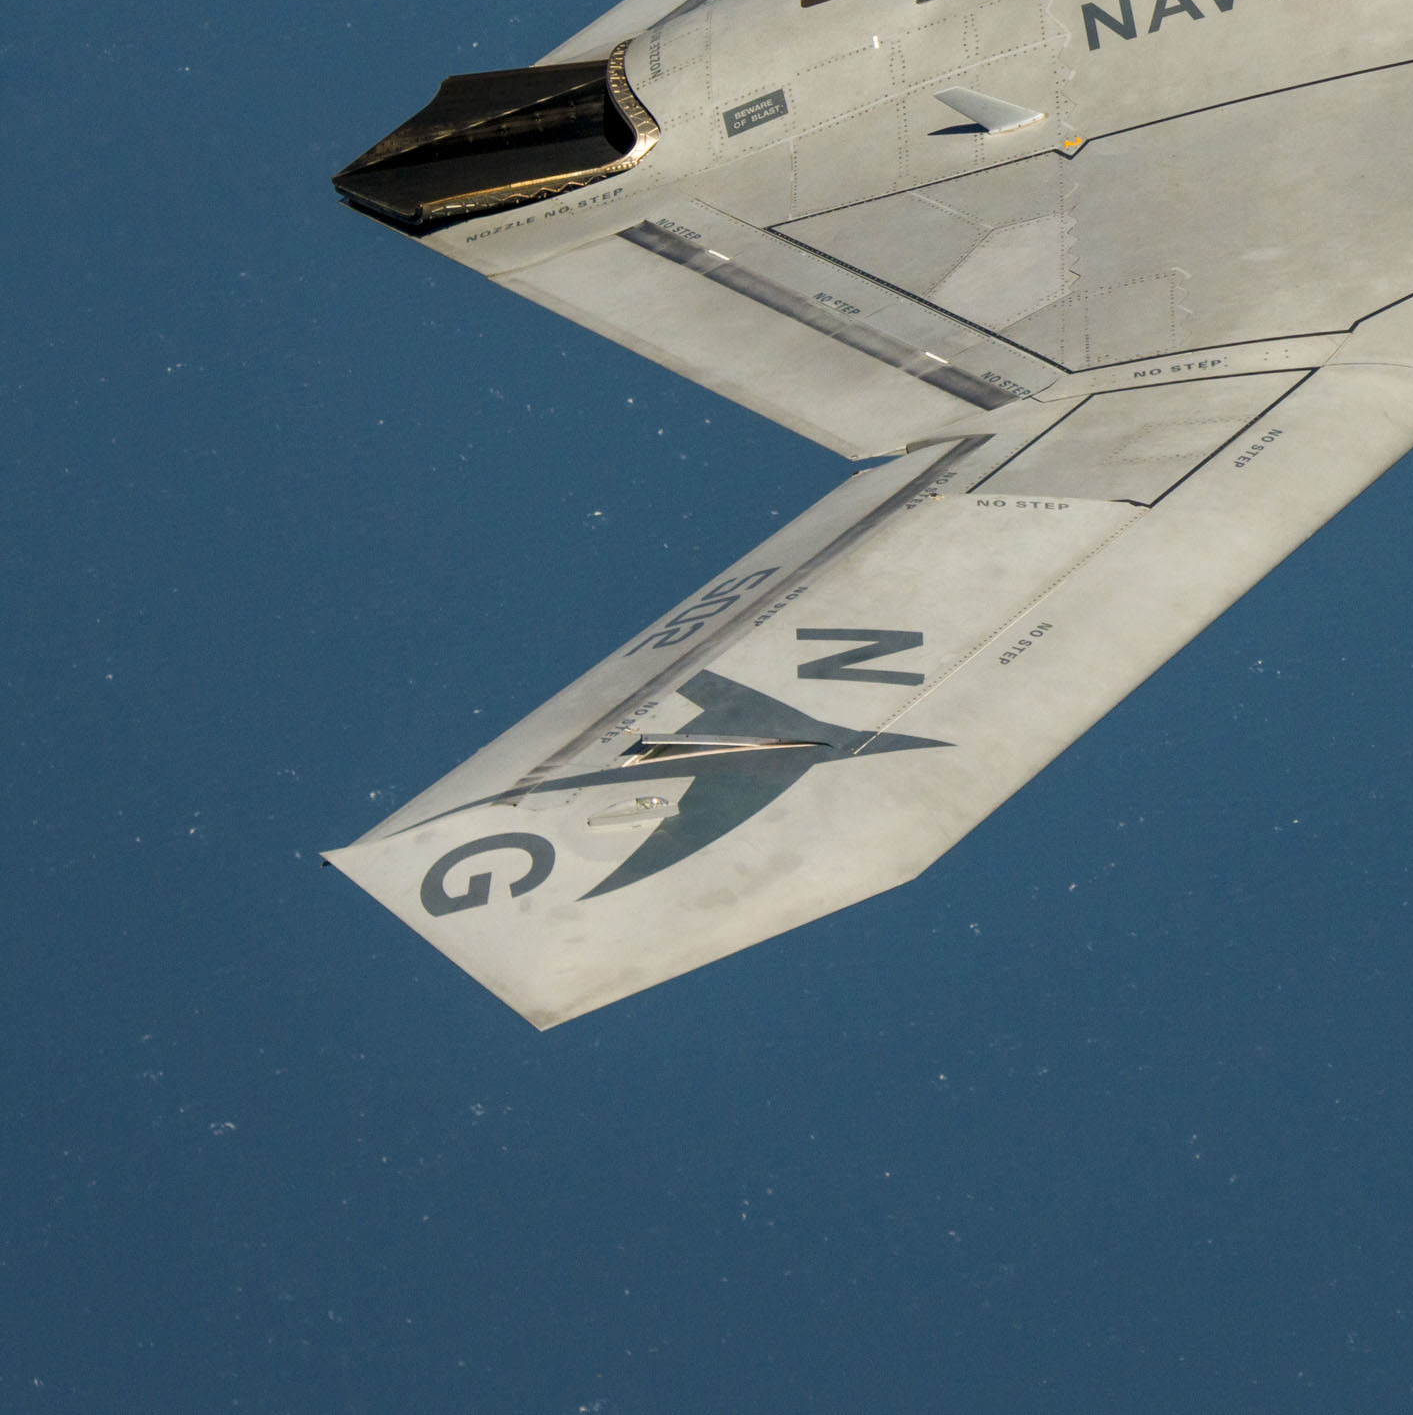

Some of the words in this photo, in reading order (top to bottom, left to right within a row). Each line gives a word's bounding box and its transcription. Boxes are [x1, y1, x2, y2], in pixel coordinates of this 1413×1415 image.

[649, 42, 664, 80] NOZZLE
[734, 98, 774, 120] BEWARE
[733, 118, 747, 129] OF
[466, 216, 536, 244] NOZZLE
[544, 206, 570, 219] NO
[578, 188, 624, 209] STEP
[655, 218, 676, 229] NO
[672, 225, 702, 240] STEP
[813, 292, 833, 302] NO
[833, 299, 861, 314] STEP
[1133, 368, 1162, 378] NO
[1170, 358, 1222, 373] STEP
[981, 371, 1002, 383] NO
[999, 380, 1031, 396] STEP
[1261, 428, 1283, 443] NO
[1233, 444, 1265, 468] STEP
[976, 499, 1007, 508] NO
[1015, 500, 1070, 511] STEP
[785, 586, 809, 601] NO
[623, 566, 782, 658] 502
[754, 602, 787, 627] STEP
[1029, 621, 1053, 638] NO
[796, 628, 926, 686] N
[998, 639, 1033, 665] STEP
[634, 701, 659, 716] NO
[600, 718, 636, 744] STEP
[420, 831, 556, 917] G
